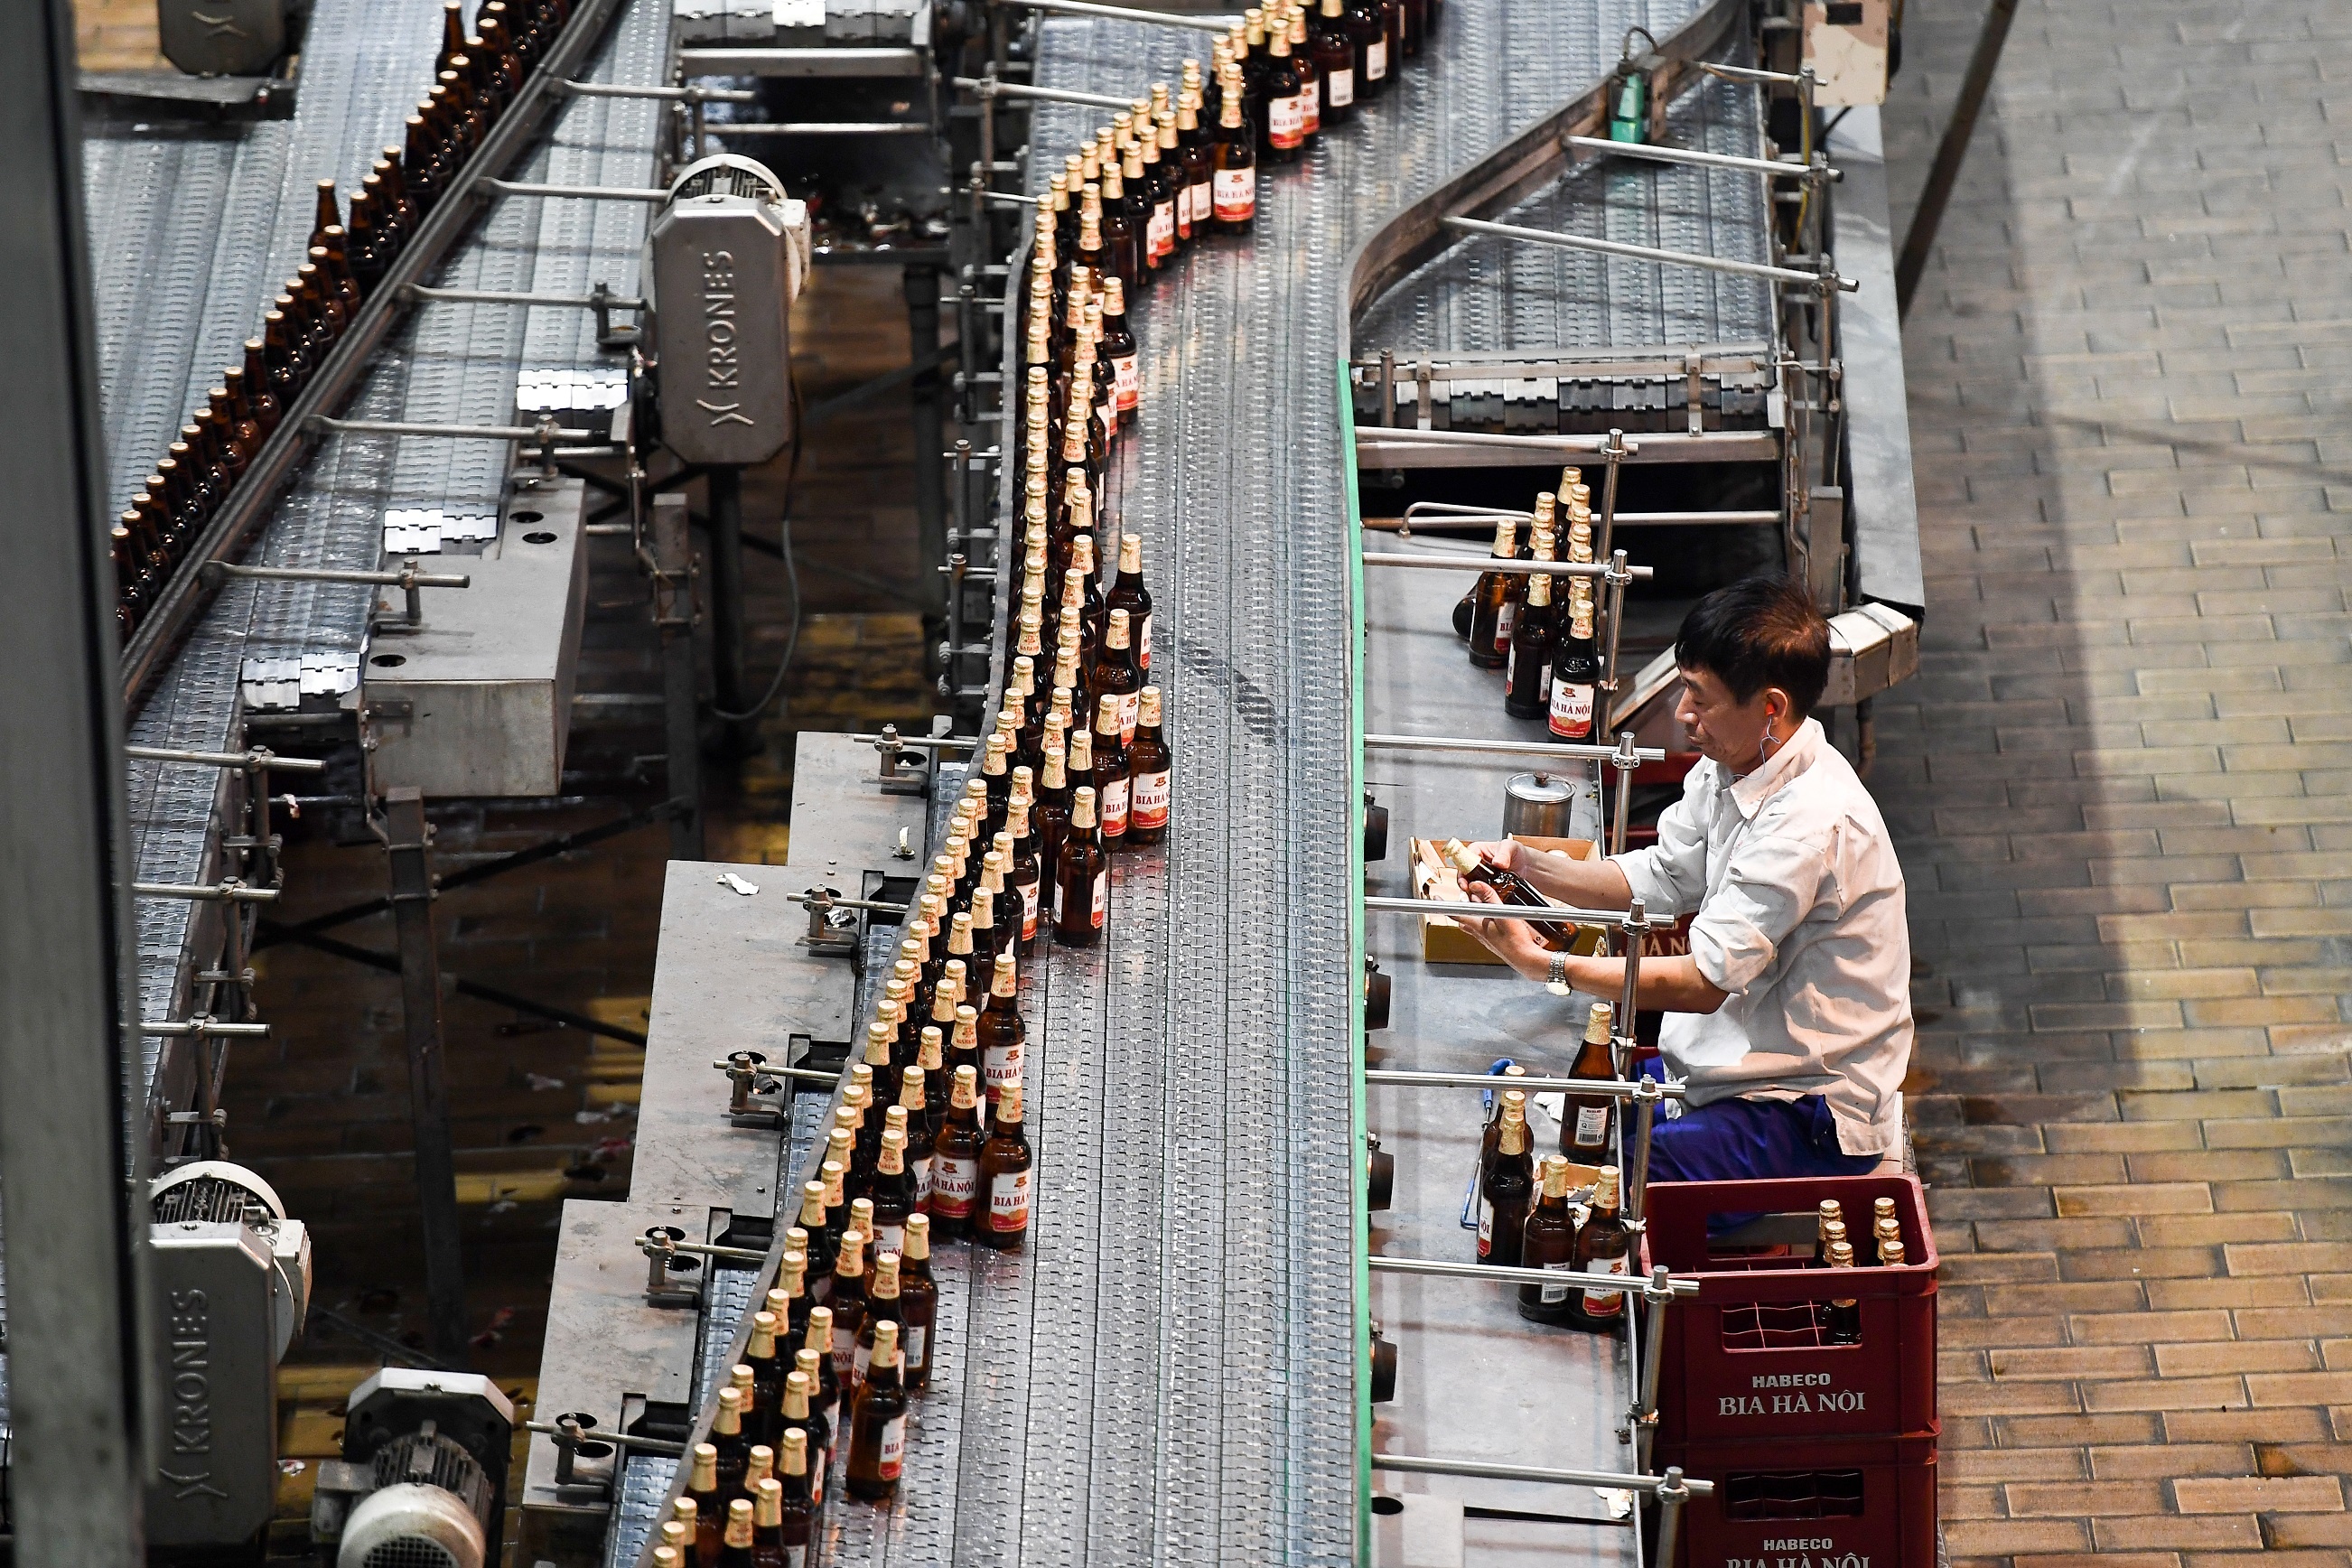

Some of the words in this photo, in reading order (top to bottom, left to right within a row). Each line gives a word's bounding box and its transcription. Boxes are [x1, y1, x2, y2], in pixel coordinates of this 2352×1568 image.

[703, 250, 738, 390] KRONES
[1135, 795, 1153, 805] BIA
[1105, 803, 1121, 814] BIA
[986, 1068, 1003, 1079] BIA
[1004, 1065, 1018, 1079] HÀ
[941, 1179, 956, 1192] HÀ
[957, 1181, 974, 1194] NỘI
[994, 1196, 1012, 1207] BIA
[172, 1289, 210, 1455] KRONES
[1752, 1373, 1831, 1388] HABECO
[1718, 1395, 1767, 1416] BIA
[1771, 1391, 1812, 1414] HÀ
[1817, 1389, 1866, 1414] NỘI
[884, 1442, 900, 1454] BIA
[1763, 1538, 1833, 1551] HABECO
